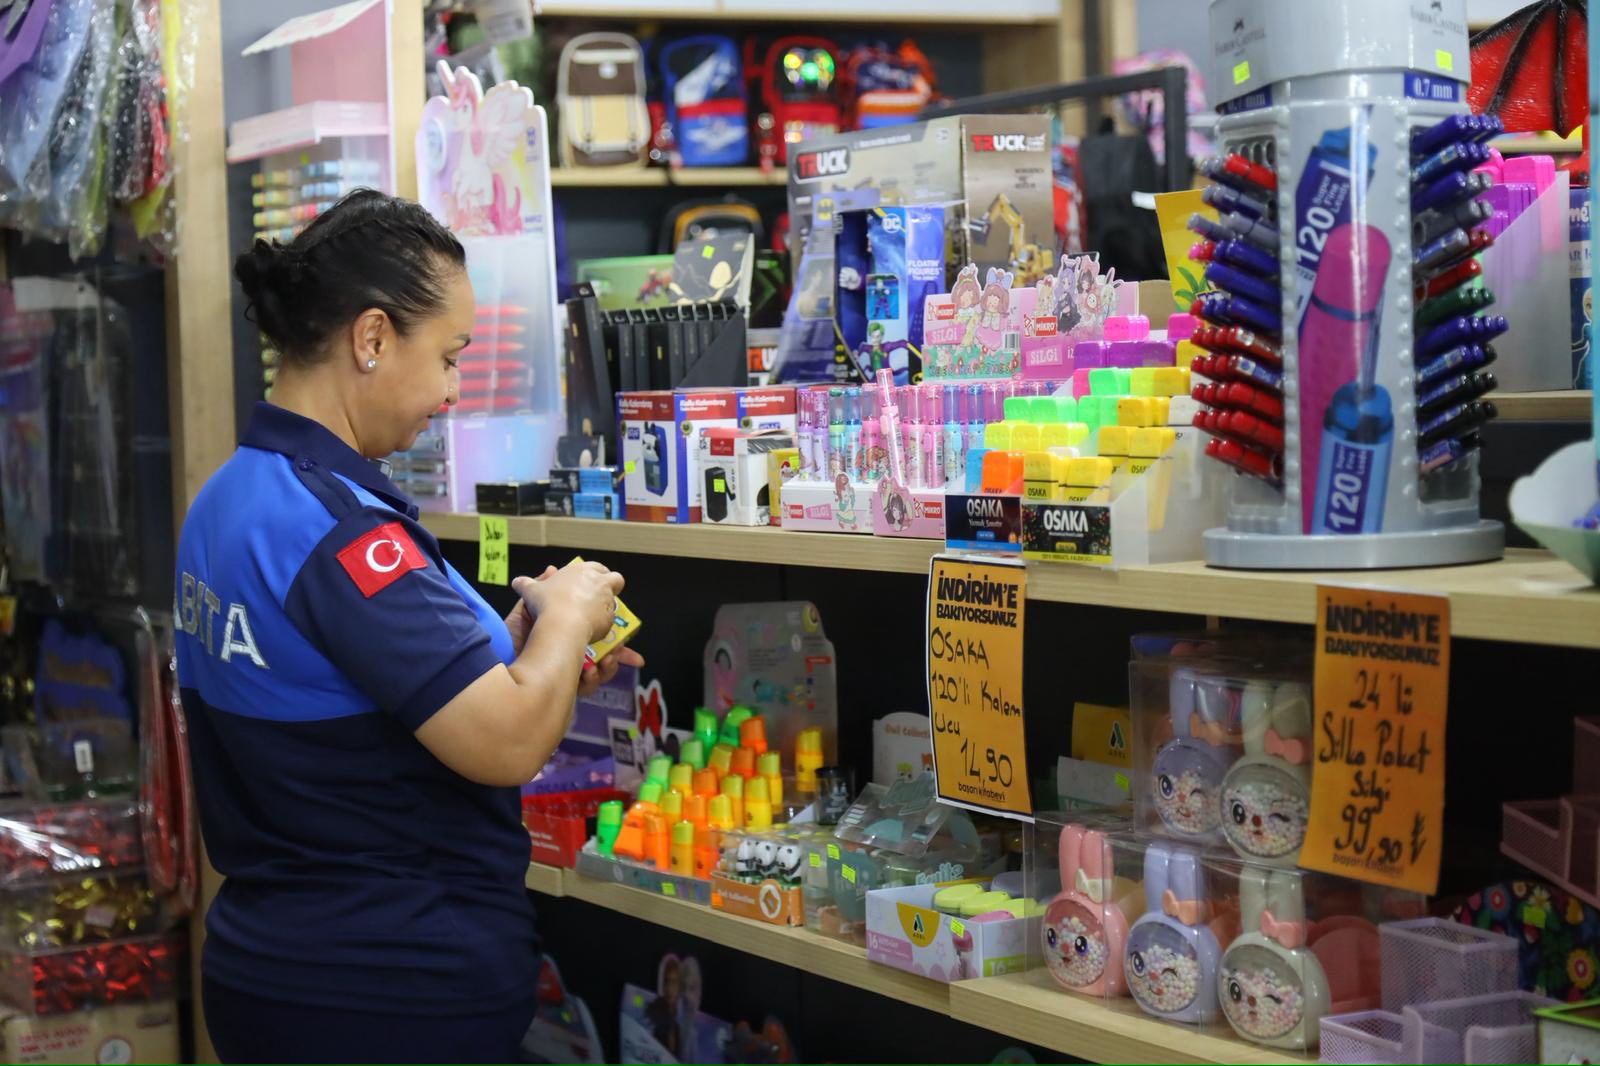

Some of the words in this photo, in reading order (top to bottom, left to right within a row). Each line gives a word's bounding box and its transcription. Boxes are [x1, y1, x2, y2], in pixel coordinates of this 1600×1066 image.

[1432, 83, 1453, 99] mm
[972, 134, 1025, 152] TRUCK
[798, 149, 848, 178] TRUCK
[882, 217, 902, 229] DC
[1296, 206, 1336, 269] 120
[1027, 488, 1047, 497] OSAKA
[1329, 472, 1363, 529] 120
[966, 498, 1004, 518] OSAKA
[1043, 510, 1089, 533] OSAKA
[937, 604, 1017, 628] BAKIYORSUNUZ
[931, 626, 990, 670] OSAKA
[980, 680, 1021, 717] Kalem
[934, 711, 960, 736] Ucu
[960, 738, 1013, 788] 14,90
[867, 932, 879, 949] 16
